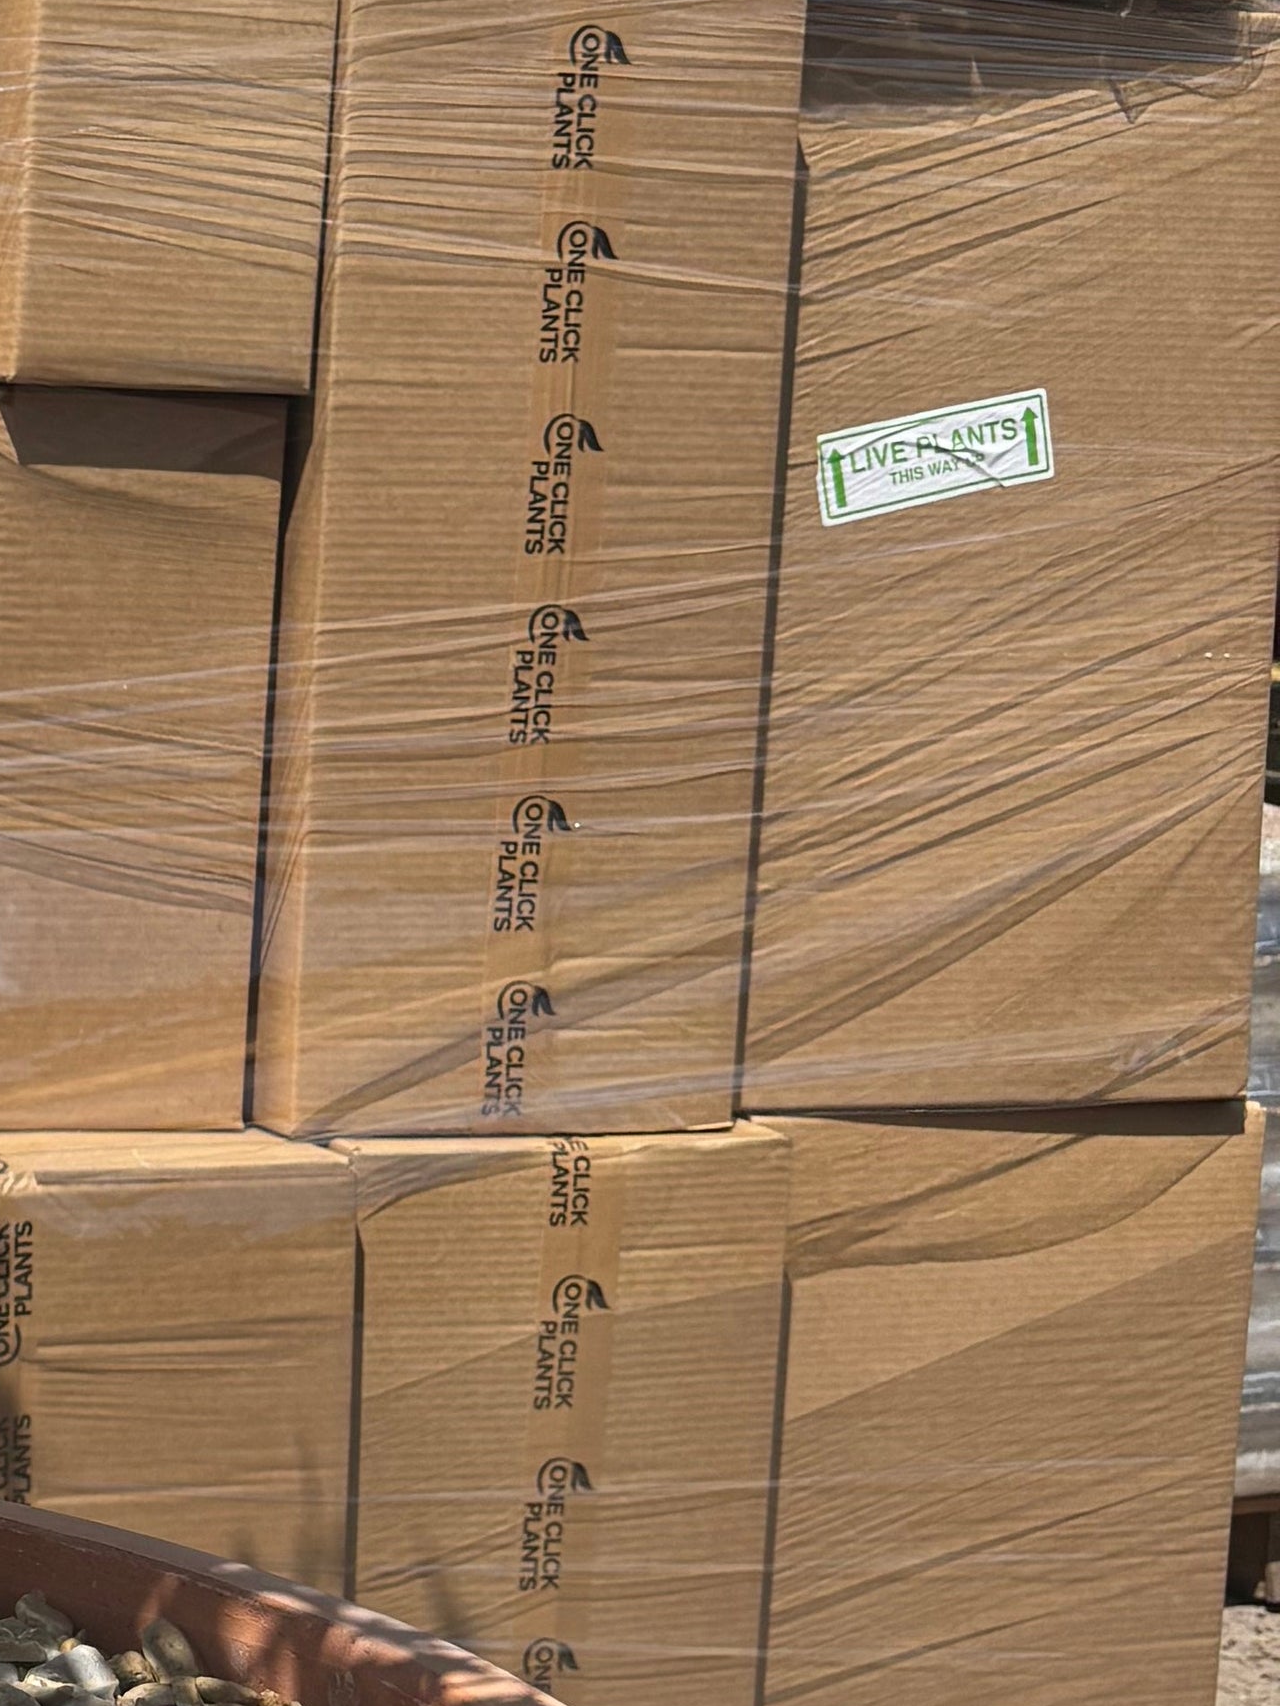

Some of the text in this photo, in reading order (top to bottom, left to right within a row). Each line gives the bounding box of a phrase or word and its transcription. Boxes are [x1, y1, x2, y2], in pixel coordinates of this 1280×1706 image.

[552, 72, 577, 170] PLANTS
[573, 31, 600, 170] ONE CLICK
[539, 267, 564, 364] PLANTS
[560, 227, 588, 364] ONE CLICK
[546, 420, 575, 555] ONE CLICK
[848, 441, 908, 474] LIVE
[890, 466, 924, 485] THIS
[928, 459, 959, 477] WAY
[525, 460, 550, 556] PLANTS
[509, 650, 535, 745] PLANTS
[531, 609, 559, 745] ONE CLICK
[493, 841, 518, 933] PLANTS
[514, 801, 544, 933] ONE CLICK
[481, 1026, 505, 1118] PLANTS
[501, 985, 529, 1118] ONE CLICK
[548, 1140, 568, 1227] PLANTS
[570, 1155, 591, 1226] CLICK
[14, 1220, 33, 1316] PLANTS
[533, 1320, 557, 1410] PLANTS
[554, 1282, 581, 1409] ONE CLICK
[518, 1501, 542, 1592] PLANTS
[539, 1464, 567, 1591] ONE CLICK
